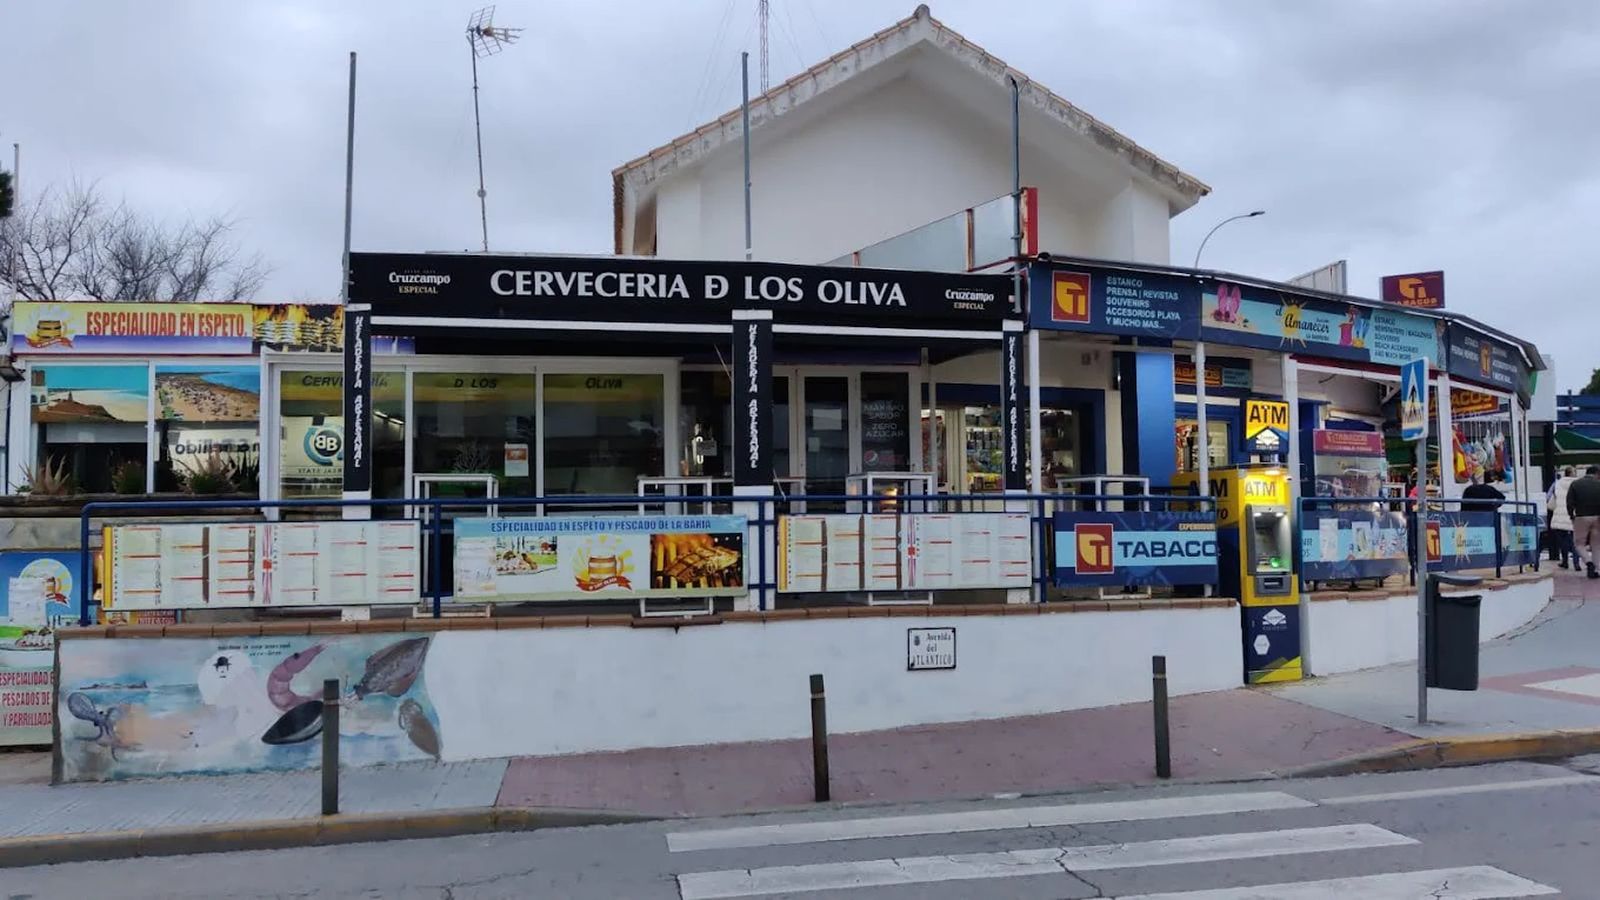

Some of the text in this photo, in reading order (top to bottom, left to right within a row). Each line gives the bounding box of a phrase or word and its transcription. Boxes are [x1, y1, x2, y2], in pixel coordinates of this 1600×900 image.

[388, 272, 451, 286] Cruzcampo
[1106, 276, 1143, 287] ESTANCO
[398, 286, 439, 294] ESPECIAL
[490, 270, 690, 298] CERVECERIA
[744, 275, 804, 301] LOS
[816, 279, 907, 306] OLIVA
[1106, 287, 1179, 300] PRENSA REVISTAS
[945, 289, 995, 302] Cruzcampo
[953, 302, 985, 310] ESPECIAL
[1106, 297, 1150, 308] SOUVENIRS
[1105, 307, 1180, 320] ACCESORIOS PLAYA
[87, 311, 176, 336] ESPECIALIDAD
[180, 312, 195, 336] EN
[1105, 316, 1111, 325] Y
[1113, 317, 1141, 327] MUCHO
[1285, 313, 1329, 333] Amanecer
[354, 316, 363, 388] HELADERIA
[471, 378, 497, 388] LOS
[1249, 404, 1287, 425] ATM
[354, 395, 362, 468] ARTESANAL
[1188, 477, 1228, 497] AM
[1245, 481, 1276, 498] ATM
[491, 521, 556, 532] ESPECIALIDAD
[560, 521, 570, 531] EN
[572, 521, 605, 531] ESPETO
[608, 520, 614, 530] Y
[615, 520, 656, 530] PESCADO
[659, 520, 669, 529] DE
[671, 520, 681, 529] LA
[1117, 540, 1217, 558] TABACO
[927, 632, 952, 641] Avenida
[927, 643, 938, 653] del
[2, 691, 50, 706] PESCADOS DE
[3, 713, 7, 727] Y
